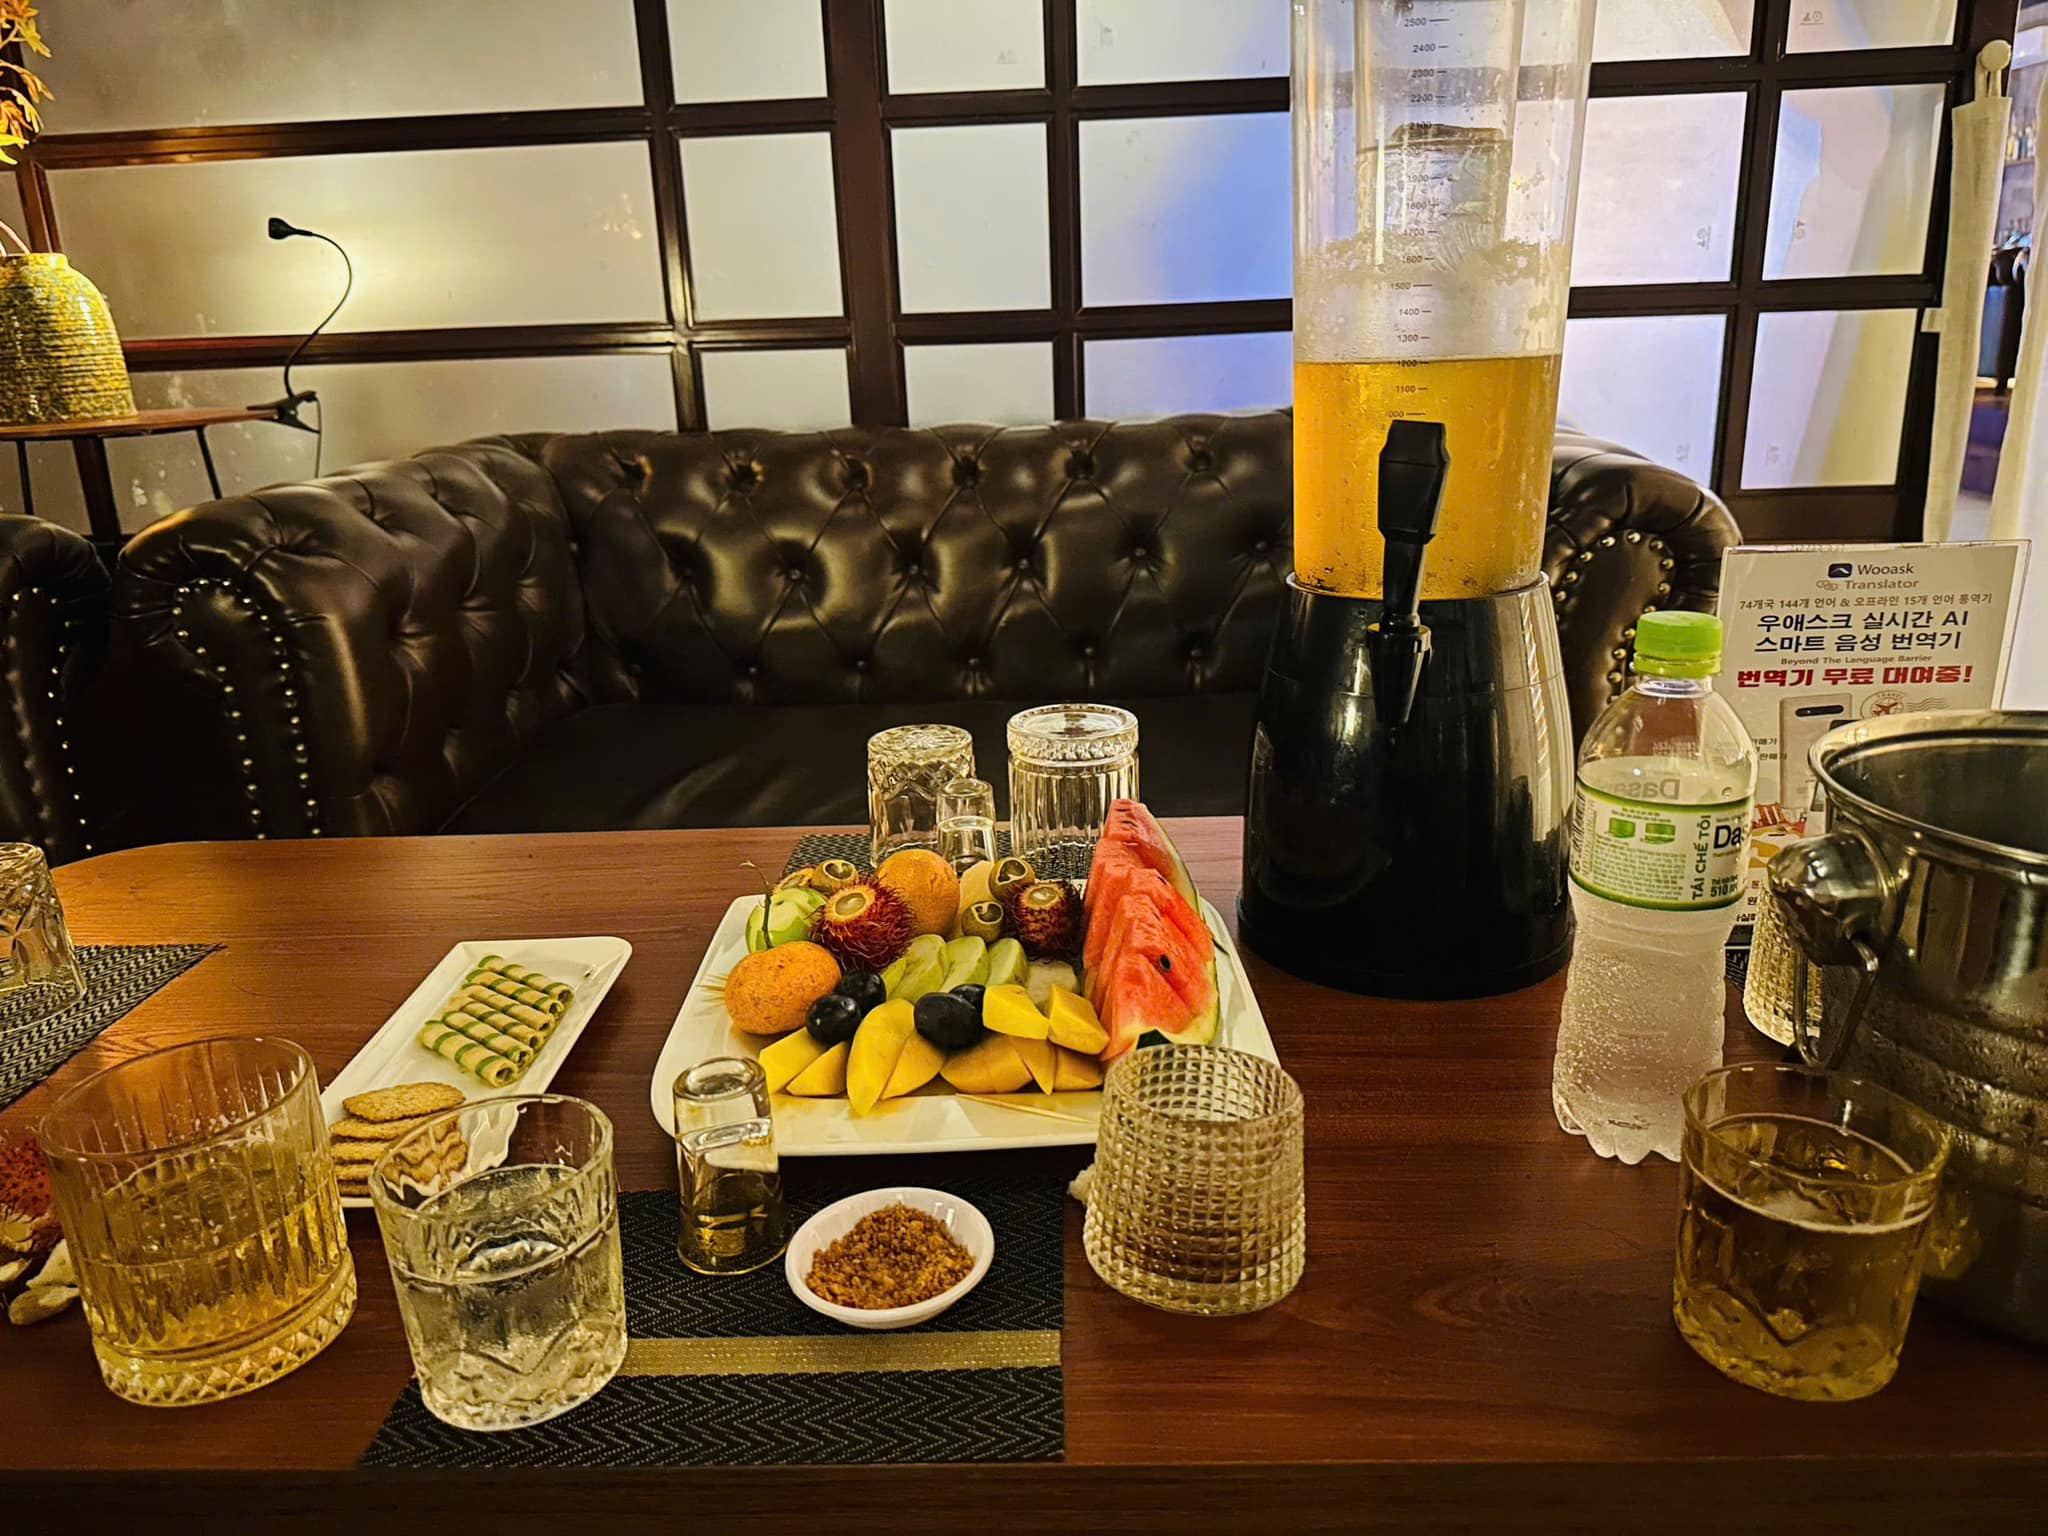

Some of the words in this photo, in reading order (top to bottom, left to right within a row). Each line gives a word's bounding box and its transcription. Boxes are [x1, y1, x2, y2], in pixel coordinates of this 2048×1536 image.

[1404, 18, 1427, 27] 2500
[1413, 43, 1436, 53] 2400
[1411, 69, 1434, 78] 2300
[1410, 94, 1433, 102] 2200
[1408, 174, 1429, 183] 1900
[1402, 256, 1423, 264] 1600
[1391, 282, 1411, 290] 1500
[1400, 308, 1419, 316] 1400
[1398, 334, 1419, 342] 1300
[1396, 385, 1416, 393] 1100
[1857, 563, 1914, 575] Wooask
[1845, 579, 1919, 590] Translator
[1740, 599, 1775, 610] 74개국
[1780, 599, 1810, 609] 144개
[1815, 597, 1837, 608] 언어
[1840, 598, 1850, 607] &
[1854, 596, 1899, 607] 오프라인
[1904, 595, 1928, 606] 15개
[1933, 594, 1954, 605] 언어
[1757, 614, 1853, 632] 우애스크
[1862, 611, 1933, 630] 실시간
[1942, 611, 1969, 626] AI
[1754, 634, 1825, 653] 스마트
[1834, 632, 1881, 652] 음성
[1891, 631, 1961, 650] 번역기
[1781, 657, 1819, 665] Beyond
[1823, 656, 1841, 664] The
[1845, 655, 1894, 664] Language
[1898, 654, 1932, 662] Barrier
[1737, 668, 1814, 687] 번역기
[1822, 666, 1874, 685] 무료
[1882, 665, 1974, 684] 대여중!
[1710, 884, 1728, 897] 510
